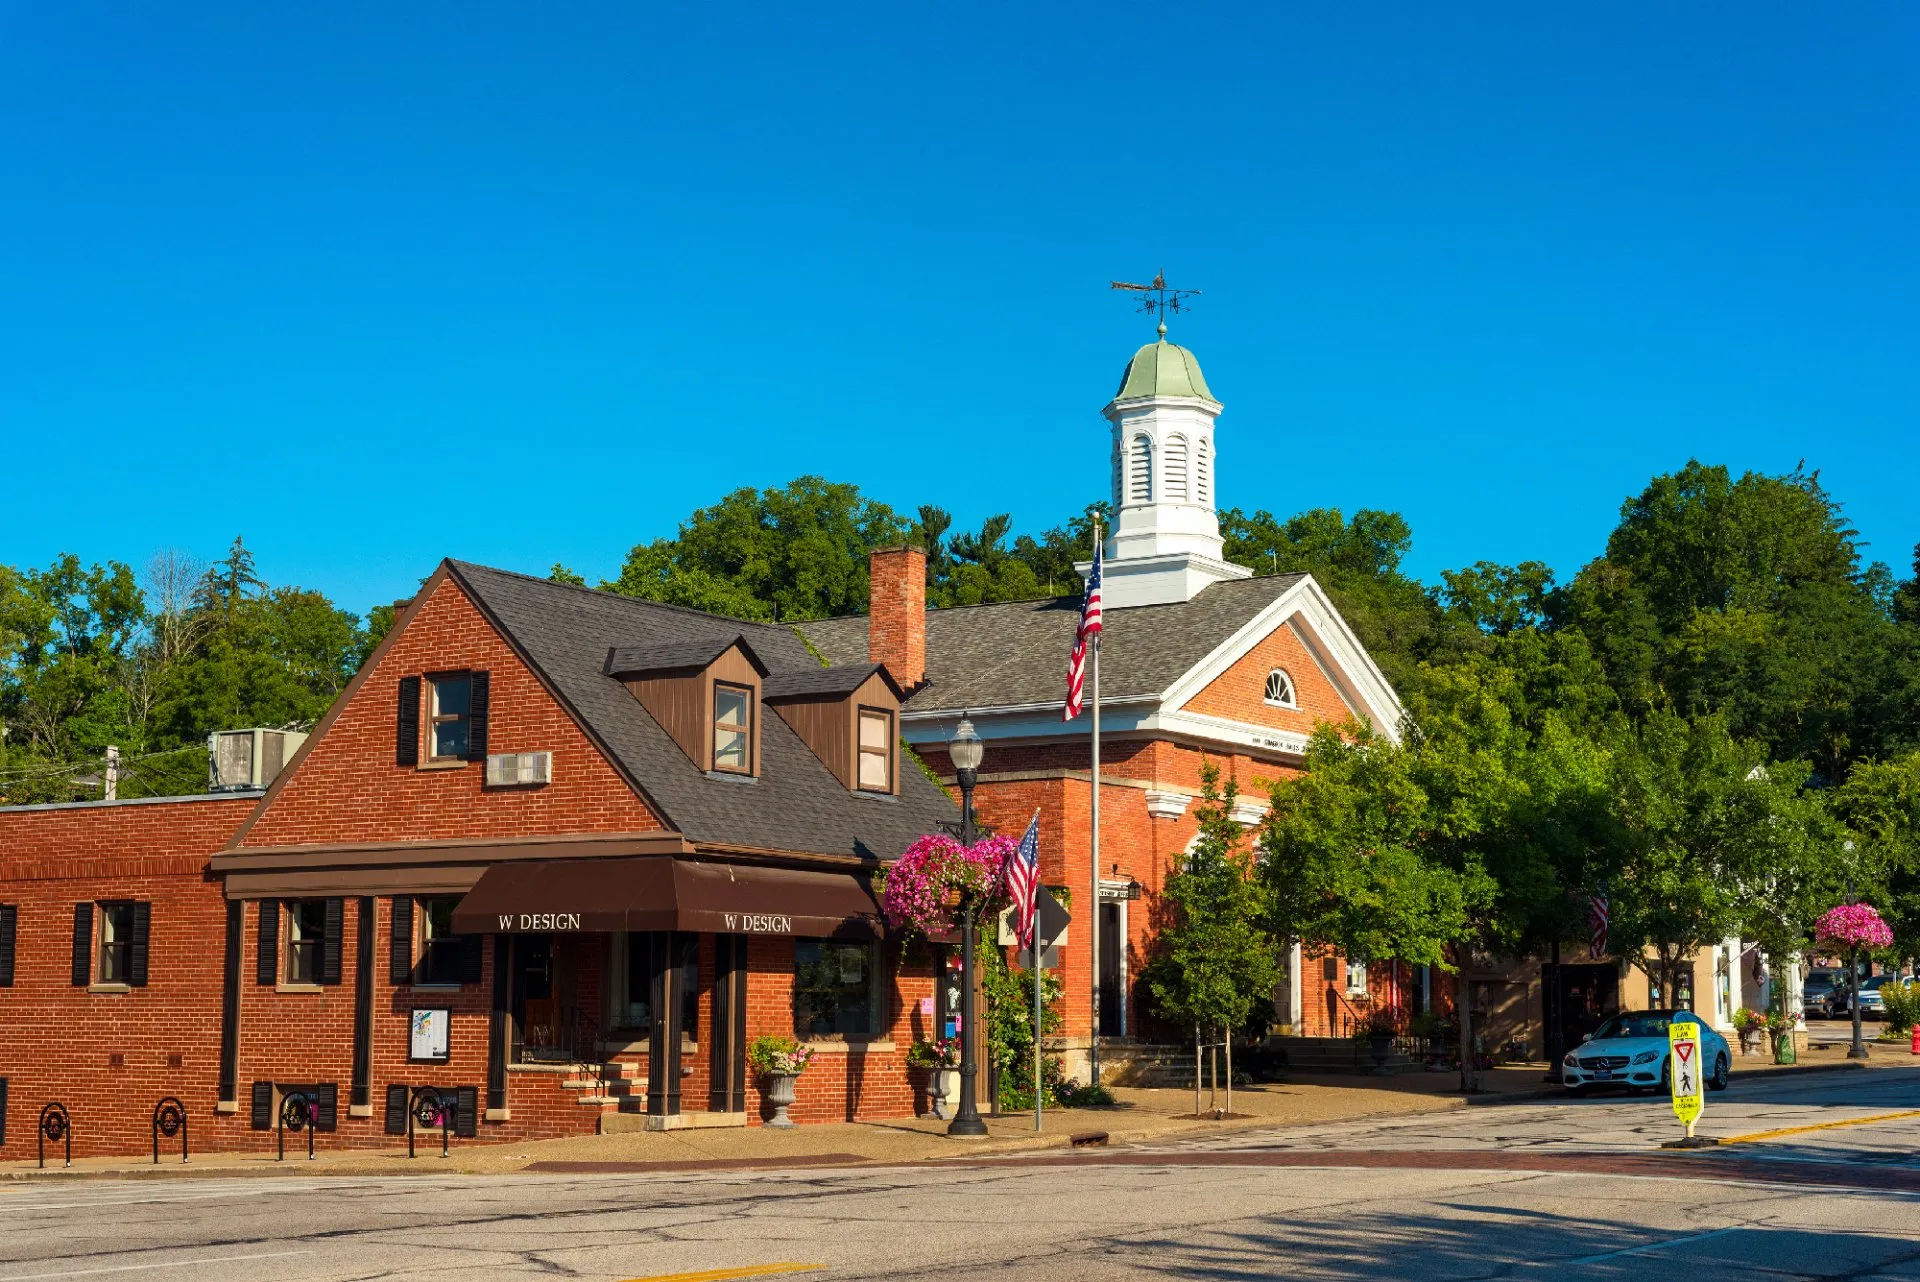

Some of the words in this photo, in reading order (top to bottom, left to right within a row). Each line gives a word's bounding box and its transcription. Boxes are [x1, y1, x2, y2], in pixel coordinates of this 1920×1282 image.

[498, 915, 514, 930] W
[520, 914, 581, 930] DESIGN
[724, 914, 737, 930] W
[743, 915, 792, 932] DESIGN
